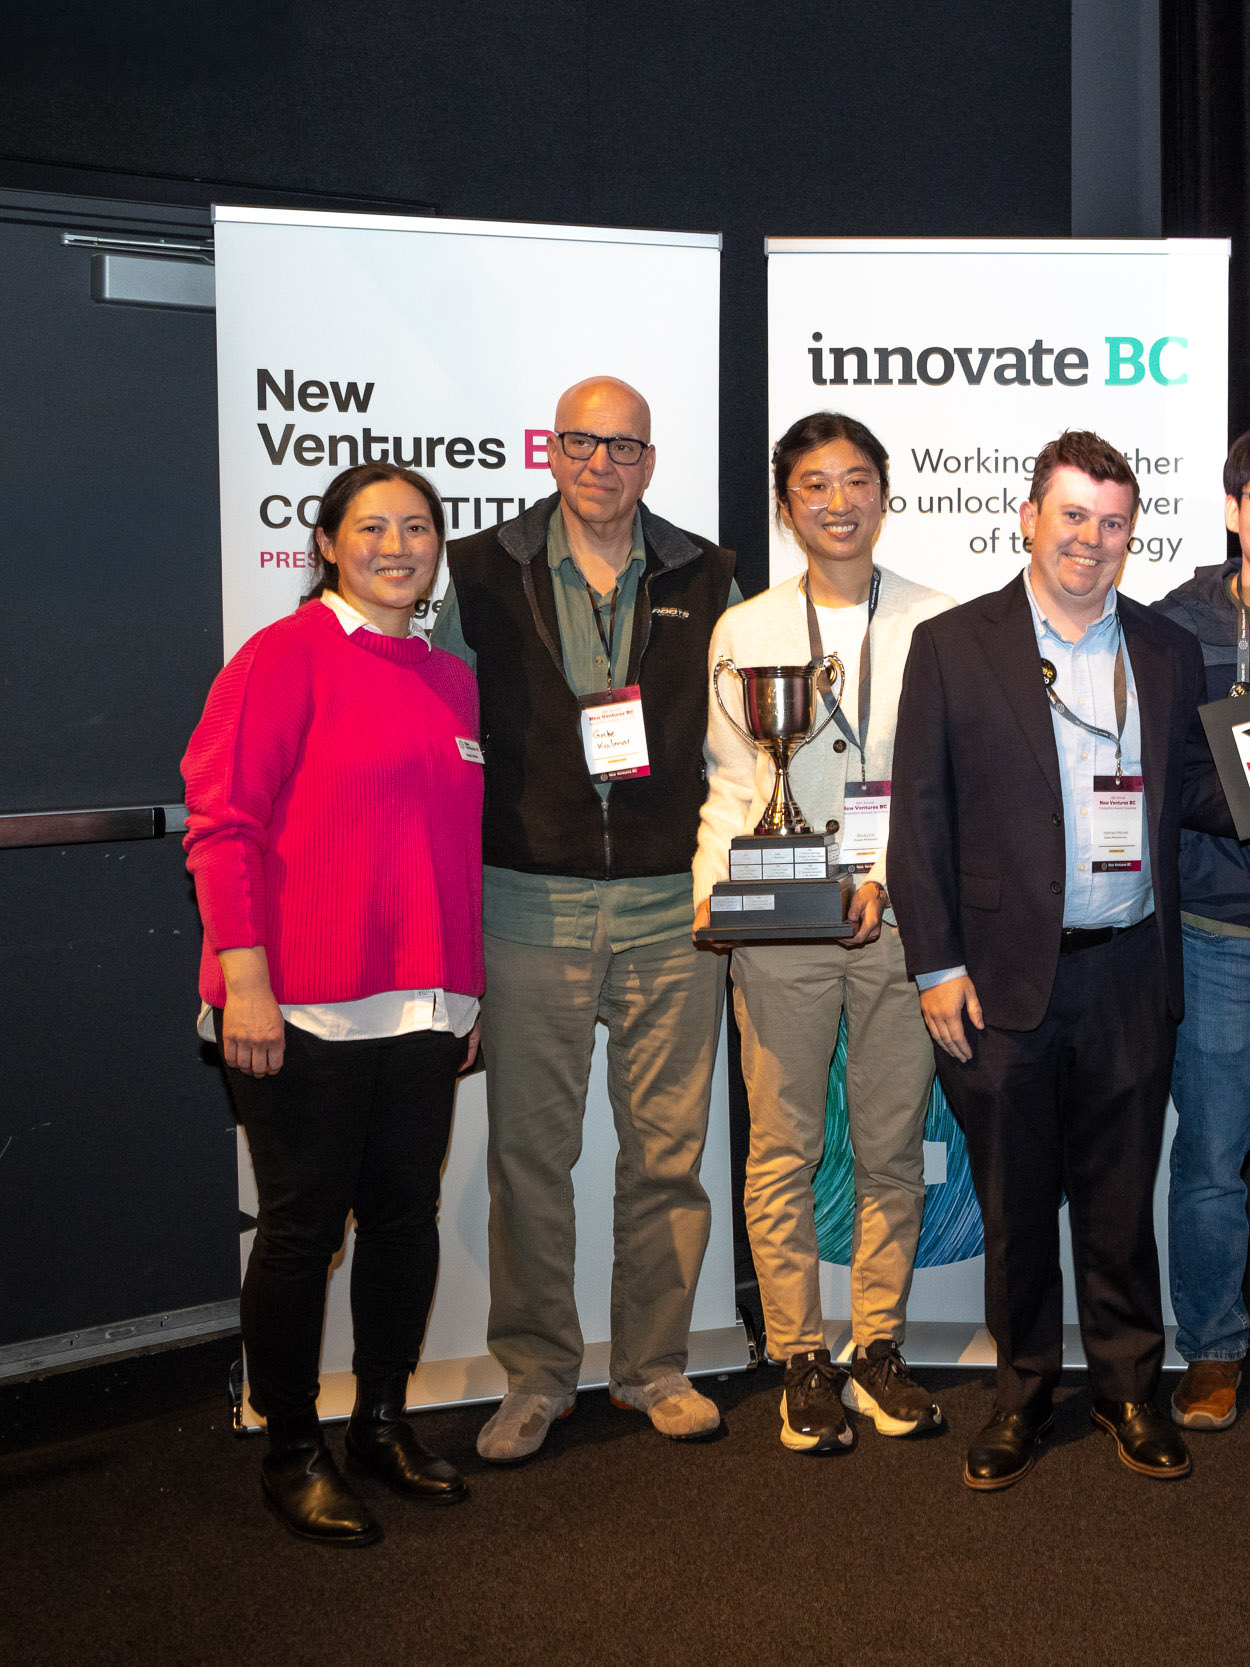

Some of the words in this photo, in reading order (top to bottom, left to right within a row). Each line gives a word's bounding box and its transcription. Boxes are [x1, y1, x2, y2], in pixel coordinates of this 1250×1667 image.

[808, 332, 1089, 386] innovate
[1104, 336, 1189, 386] BC
[256, 368, 374, 413] New
[257, 423, 507, 470] Ventures
[525, 429, 556, 469] B
[911, 447, 1037, 481] Working
[918, 487, 1018, 514] unlock
[969, 527, 1001, 554] of
